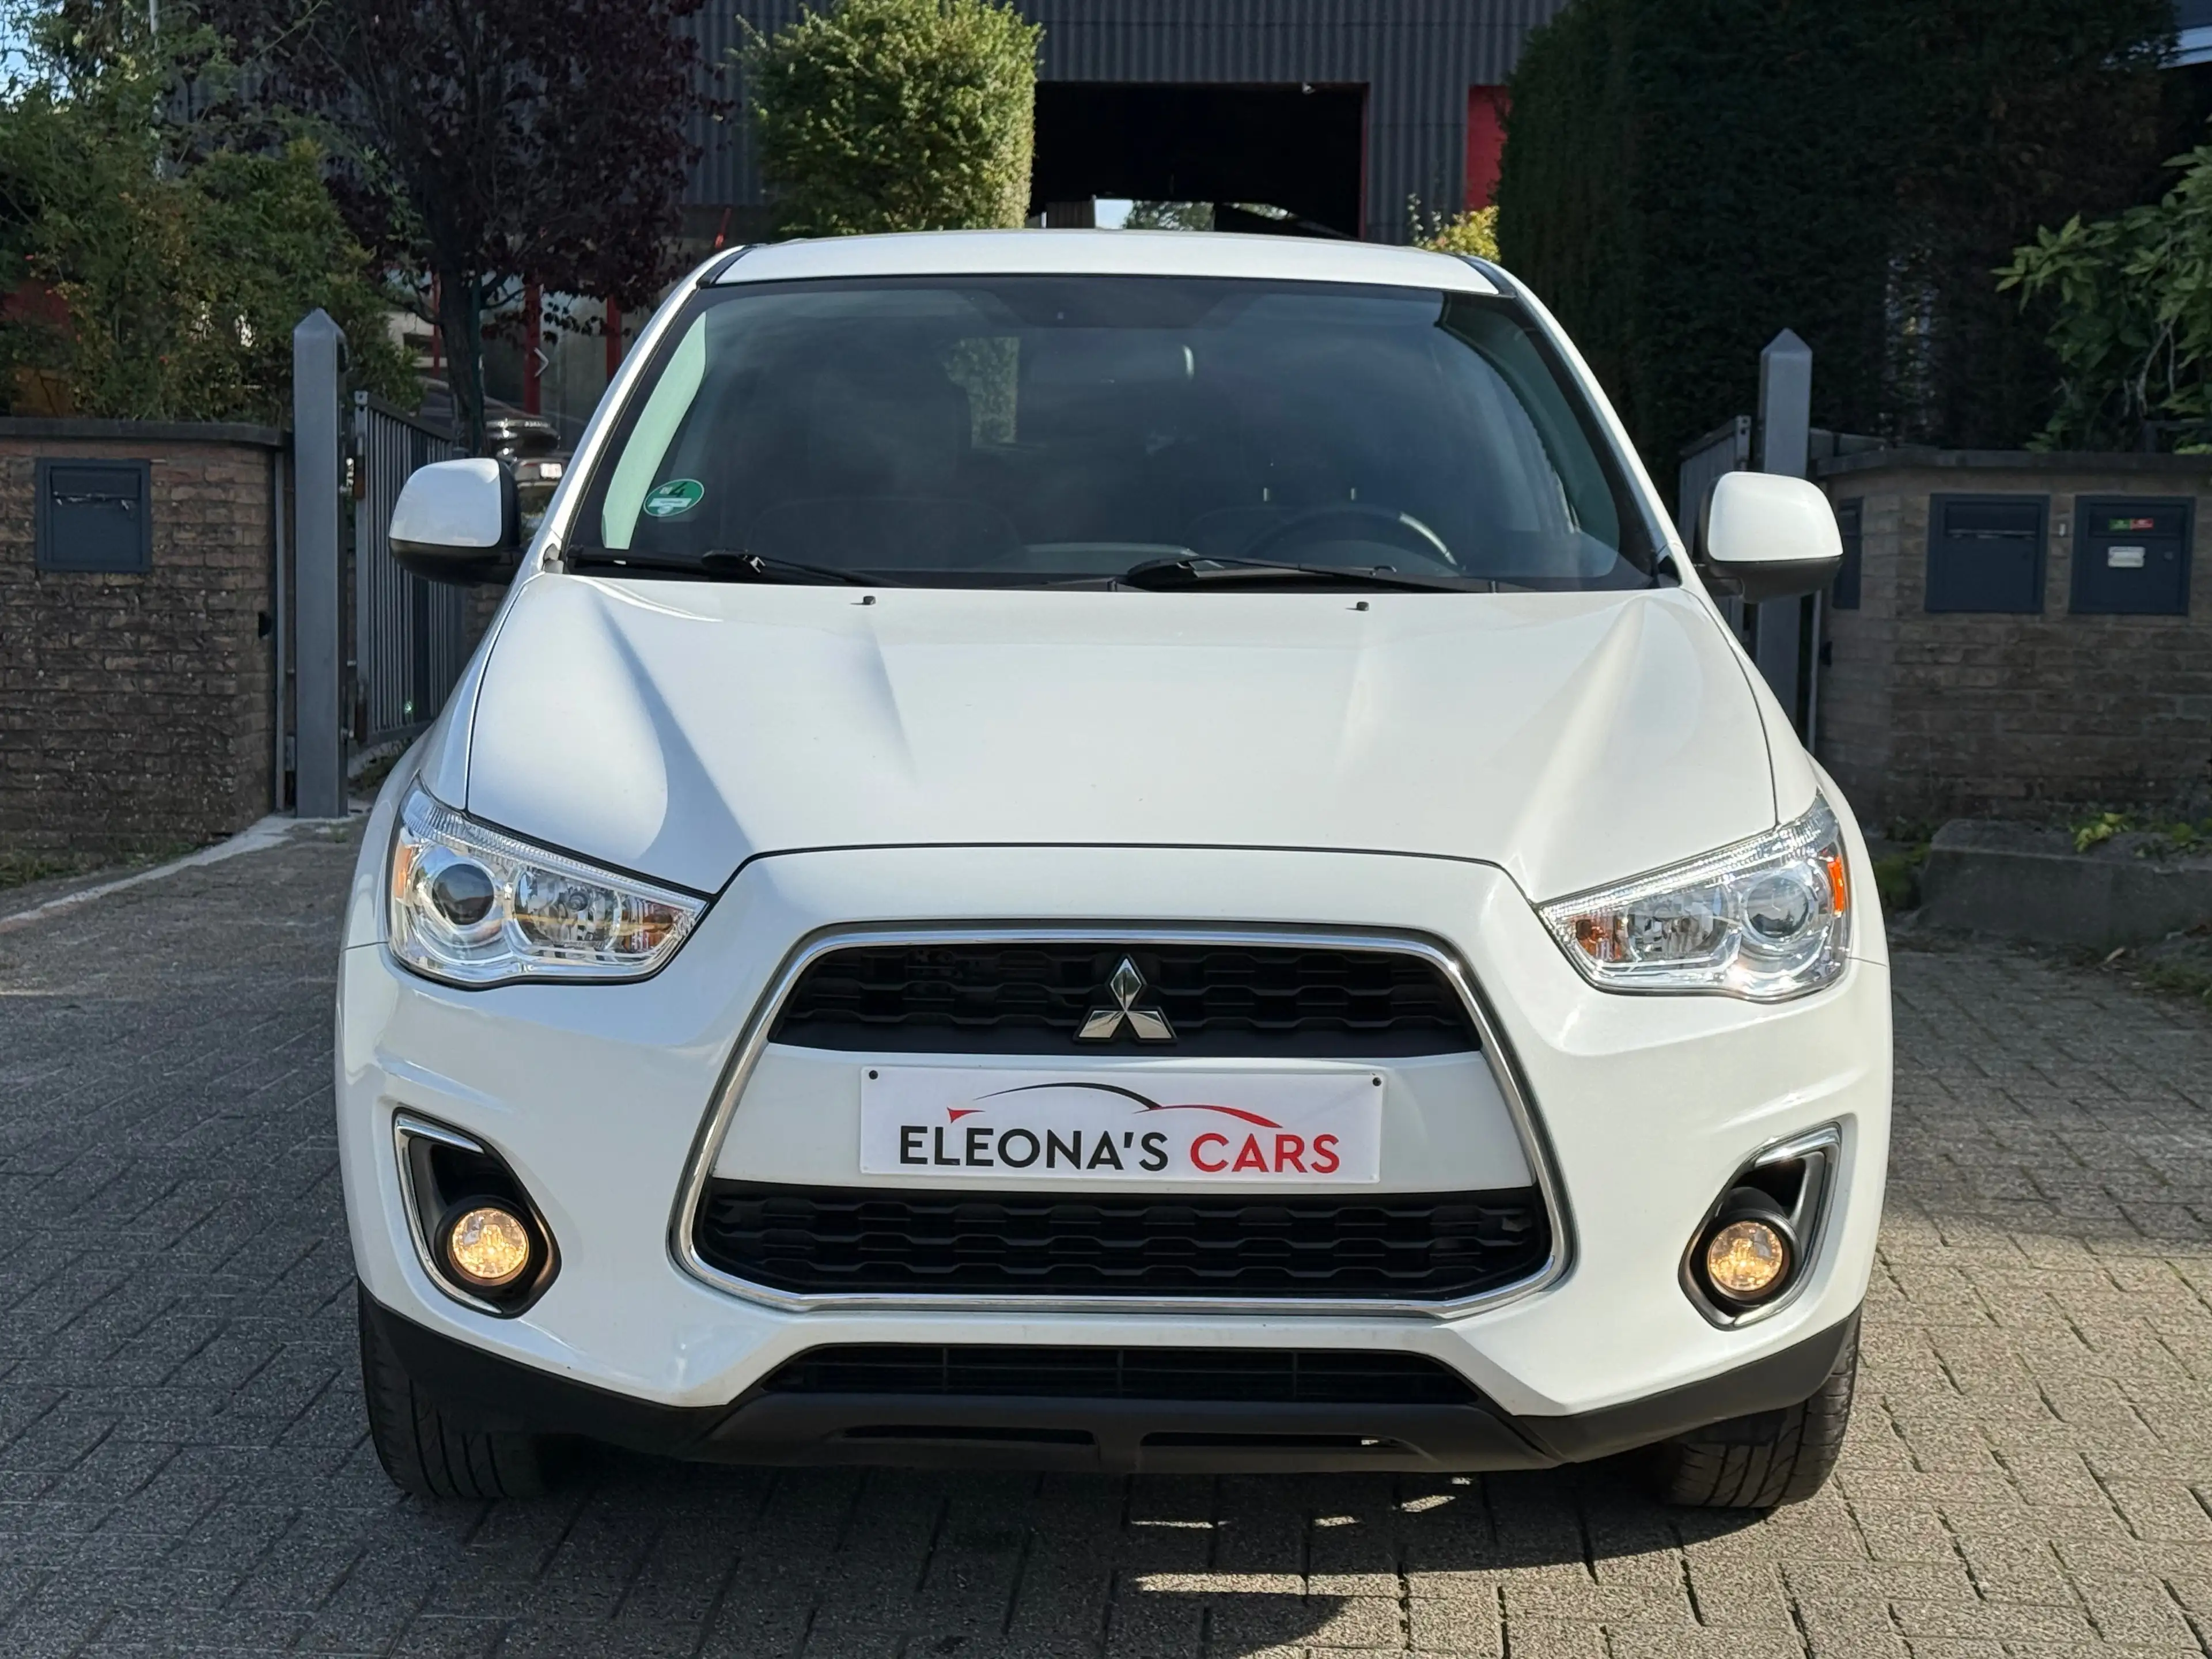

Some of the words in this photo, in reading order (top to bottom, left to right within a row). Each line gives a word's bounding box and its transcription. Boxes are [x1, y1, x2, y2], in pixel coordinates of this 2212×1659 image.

[668, 482, 687, 497] 4
[900, 1125, 1168, 1172] ELEONA'S
[1190, 1132, 1339, 1174] CARS
